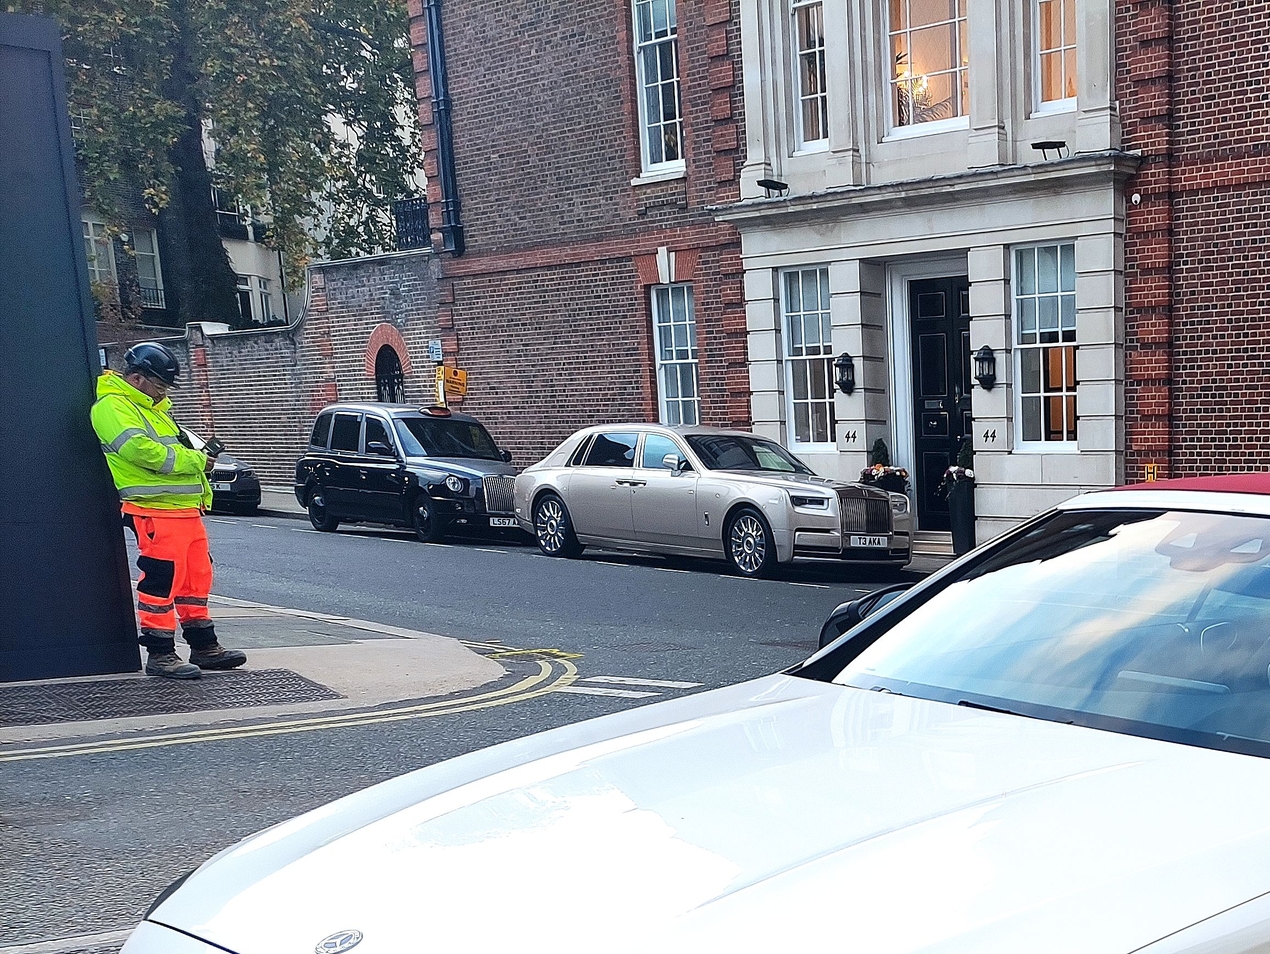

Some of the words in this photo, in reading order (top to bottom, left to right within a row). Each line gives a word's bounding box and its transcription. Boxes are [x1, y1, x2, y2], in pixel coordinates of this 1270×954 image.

[845, 430, 857, 443] 44
[983, 429, 997, 443] 44
[1147, 466, 1154, 480] H
[858, 537, 866, 545] T3
[868, 537, 881, 546] AKA
